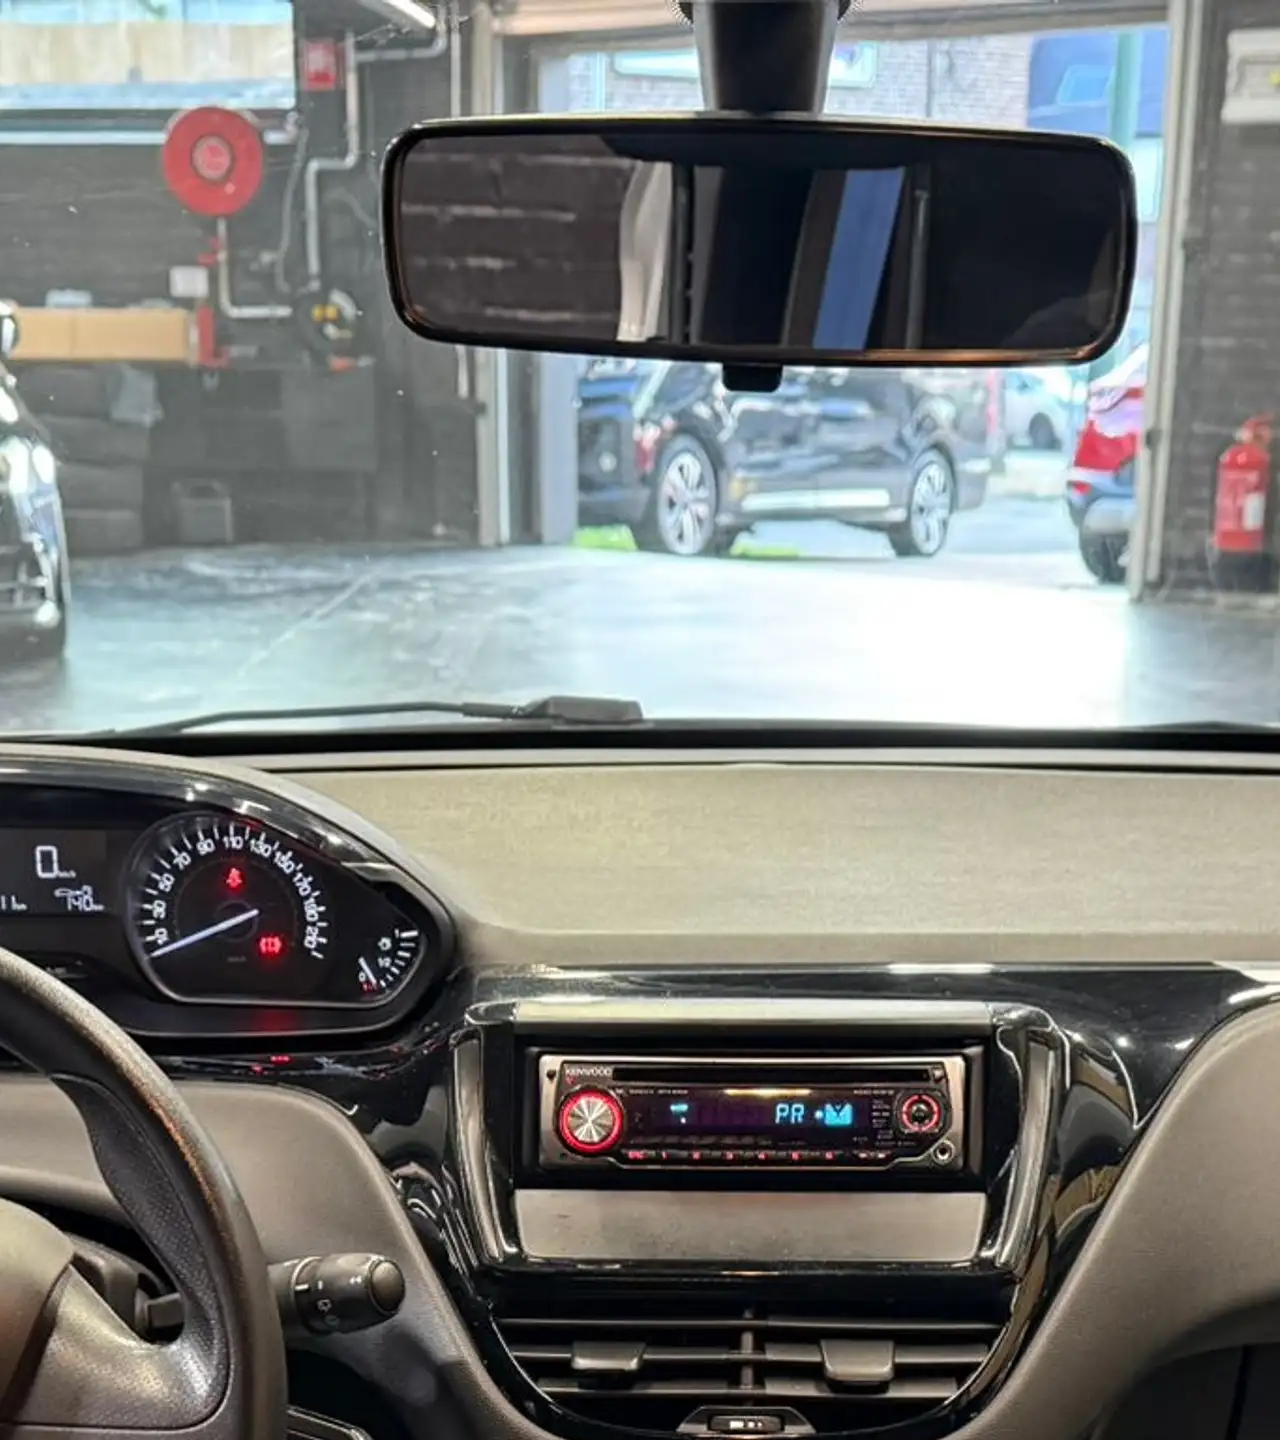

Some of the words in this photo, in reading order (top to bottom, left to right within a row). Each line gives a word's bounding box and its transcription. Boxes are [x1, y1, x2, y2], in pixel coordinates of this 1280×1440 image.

[196, 838, 216, 856] 90
[222, 835, 243, 850] 110
[250, 838, 272, 858] 130
[35, 845, 58, 879] 0
[173, 855, 192, 871] 70
[273, 850, 296, 874] 150
[158, 872, 176, 892] 50
[292, 871, 312, 897] 170
[152, 900, 167, 920] 30
[565, 1066, 613, 1077] KENWOOD
[775, 1103, 805, 1125] PR
